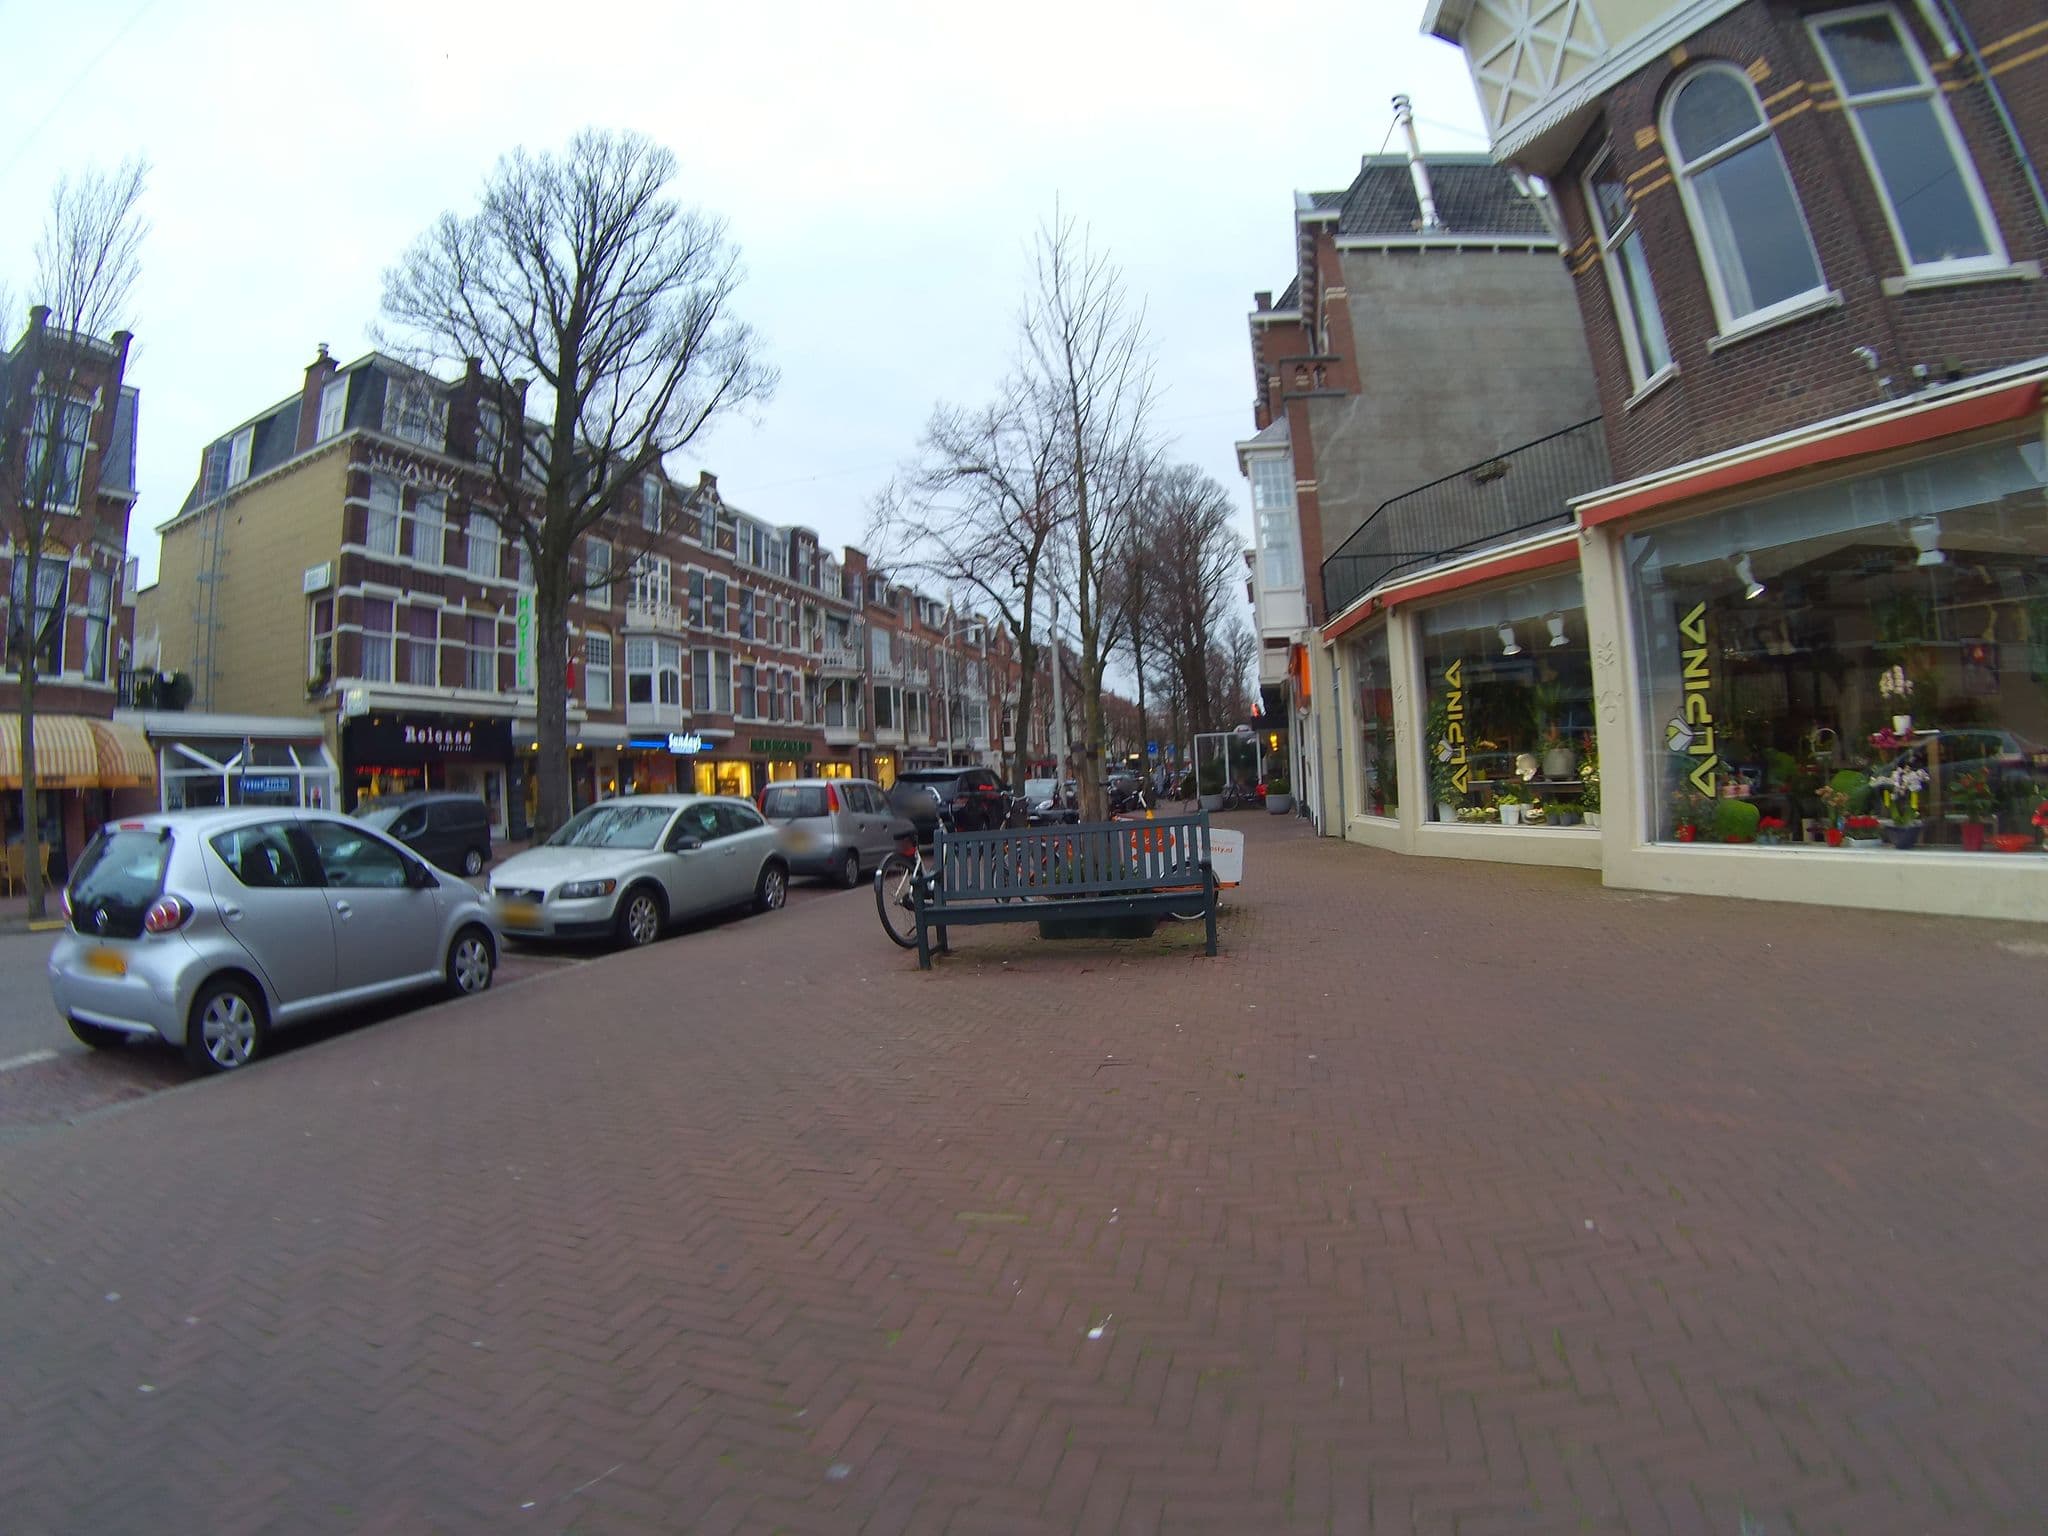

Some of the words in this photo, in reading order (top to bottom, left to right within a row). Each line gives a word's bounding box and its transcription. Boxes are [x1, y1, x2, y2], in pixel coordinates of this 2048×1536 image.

[518, 595, 529, 686] HOTEL
[404, 725, 472, 745] Release
[1445, 658, 1469, 795] ALPINA
[1679, 600, 1718, 798] ALPINA
